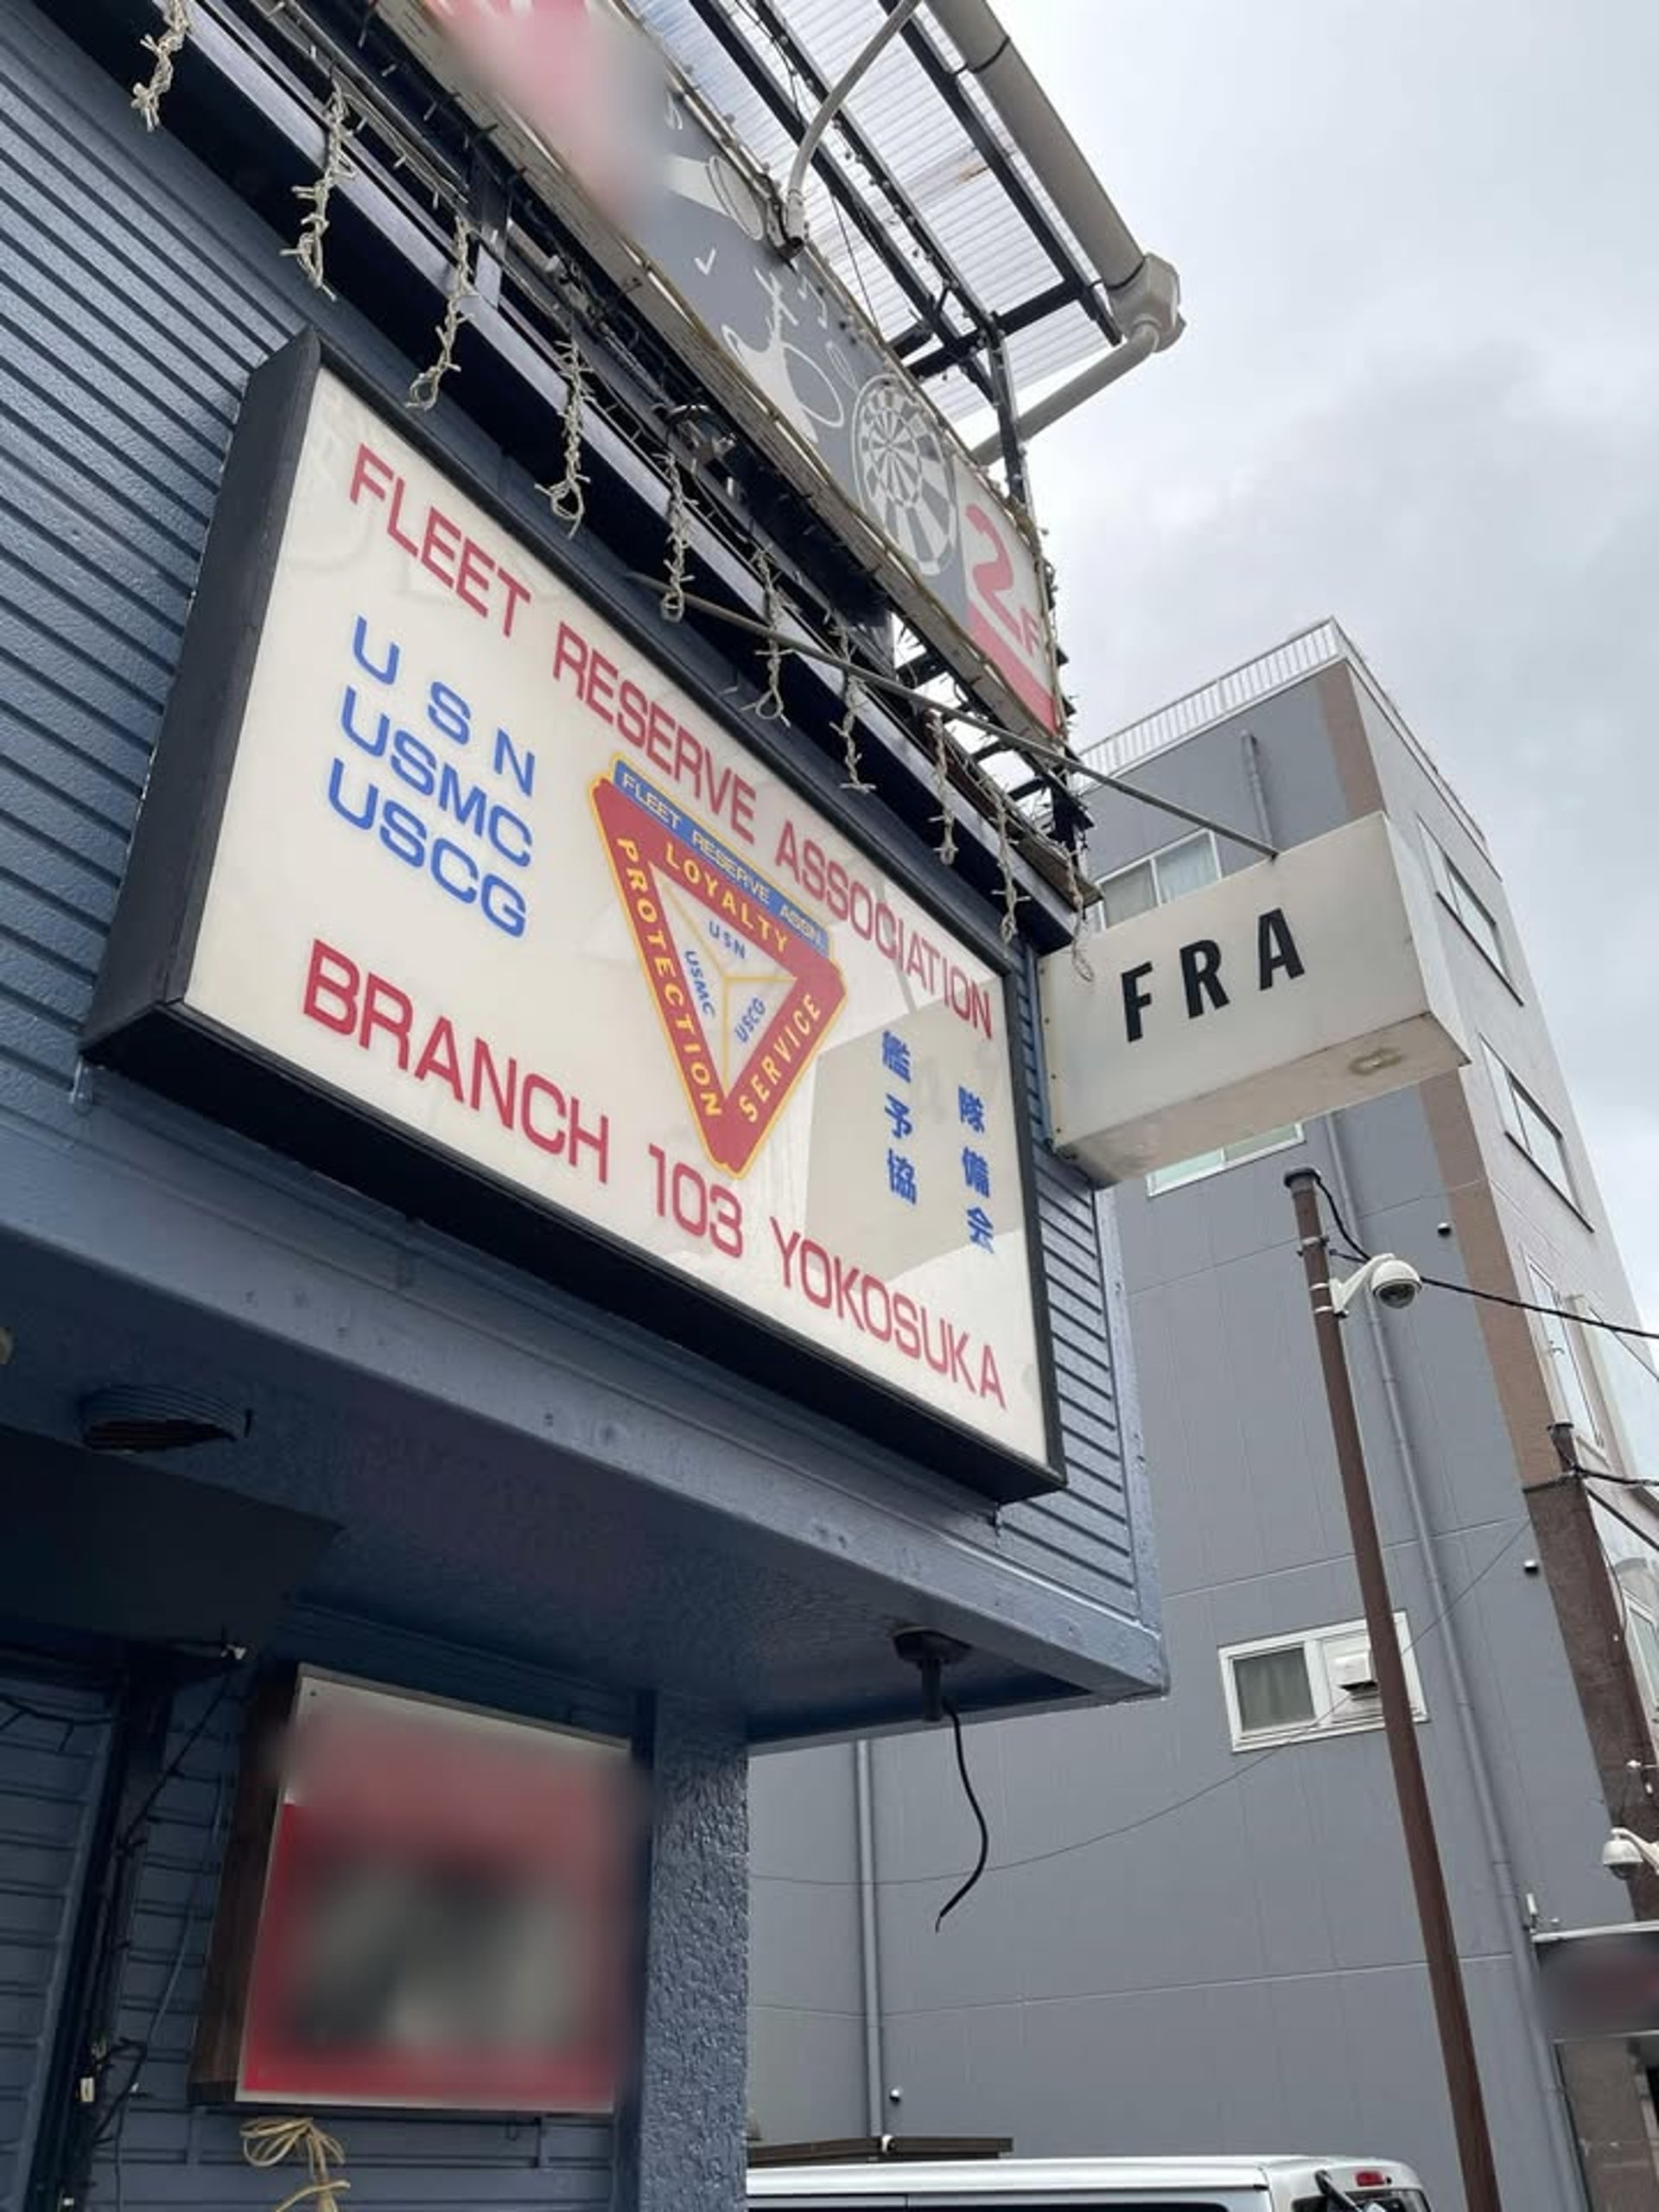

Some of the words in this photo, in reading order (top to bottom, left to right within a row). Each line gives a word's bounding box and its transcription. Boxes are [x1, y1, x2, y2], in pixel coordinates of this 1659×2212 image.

[340, 684, 533, 868] USMC
[349, 442, 531, 639] FLEET
[552, 620, 757, 845] RESERVE
[774, 818, 994, 1040] ASSOCIATION
[327, 756, 526, 938] USCG
[621, 772, 682, 830] FLEET
[691, 829, 772, 906] RESERVE
[664, 841, 789, 953] LOYALTY
[616, 836, 722, 1117] PROTECTION
[684, 950, 715, 1018] USMC
[709, 920, 746, 960] USN
[1120, 907, 1306, 1043] FRA
[734, 997, 766, 1043] USCG
[738, 994, 822, 1122] SERVICE
[302, 938, 610, 1185] BRANCH
[648, 1143, 744, 1259] 103
[770, 1216, 1008, 1411] YOKOSUKA
